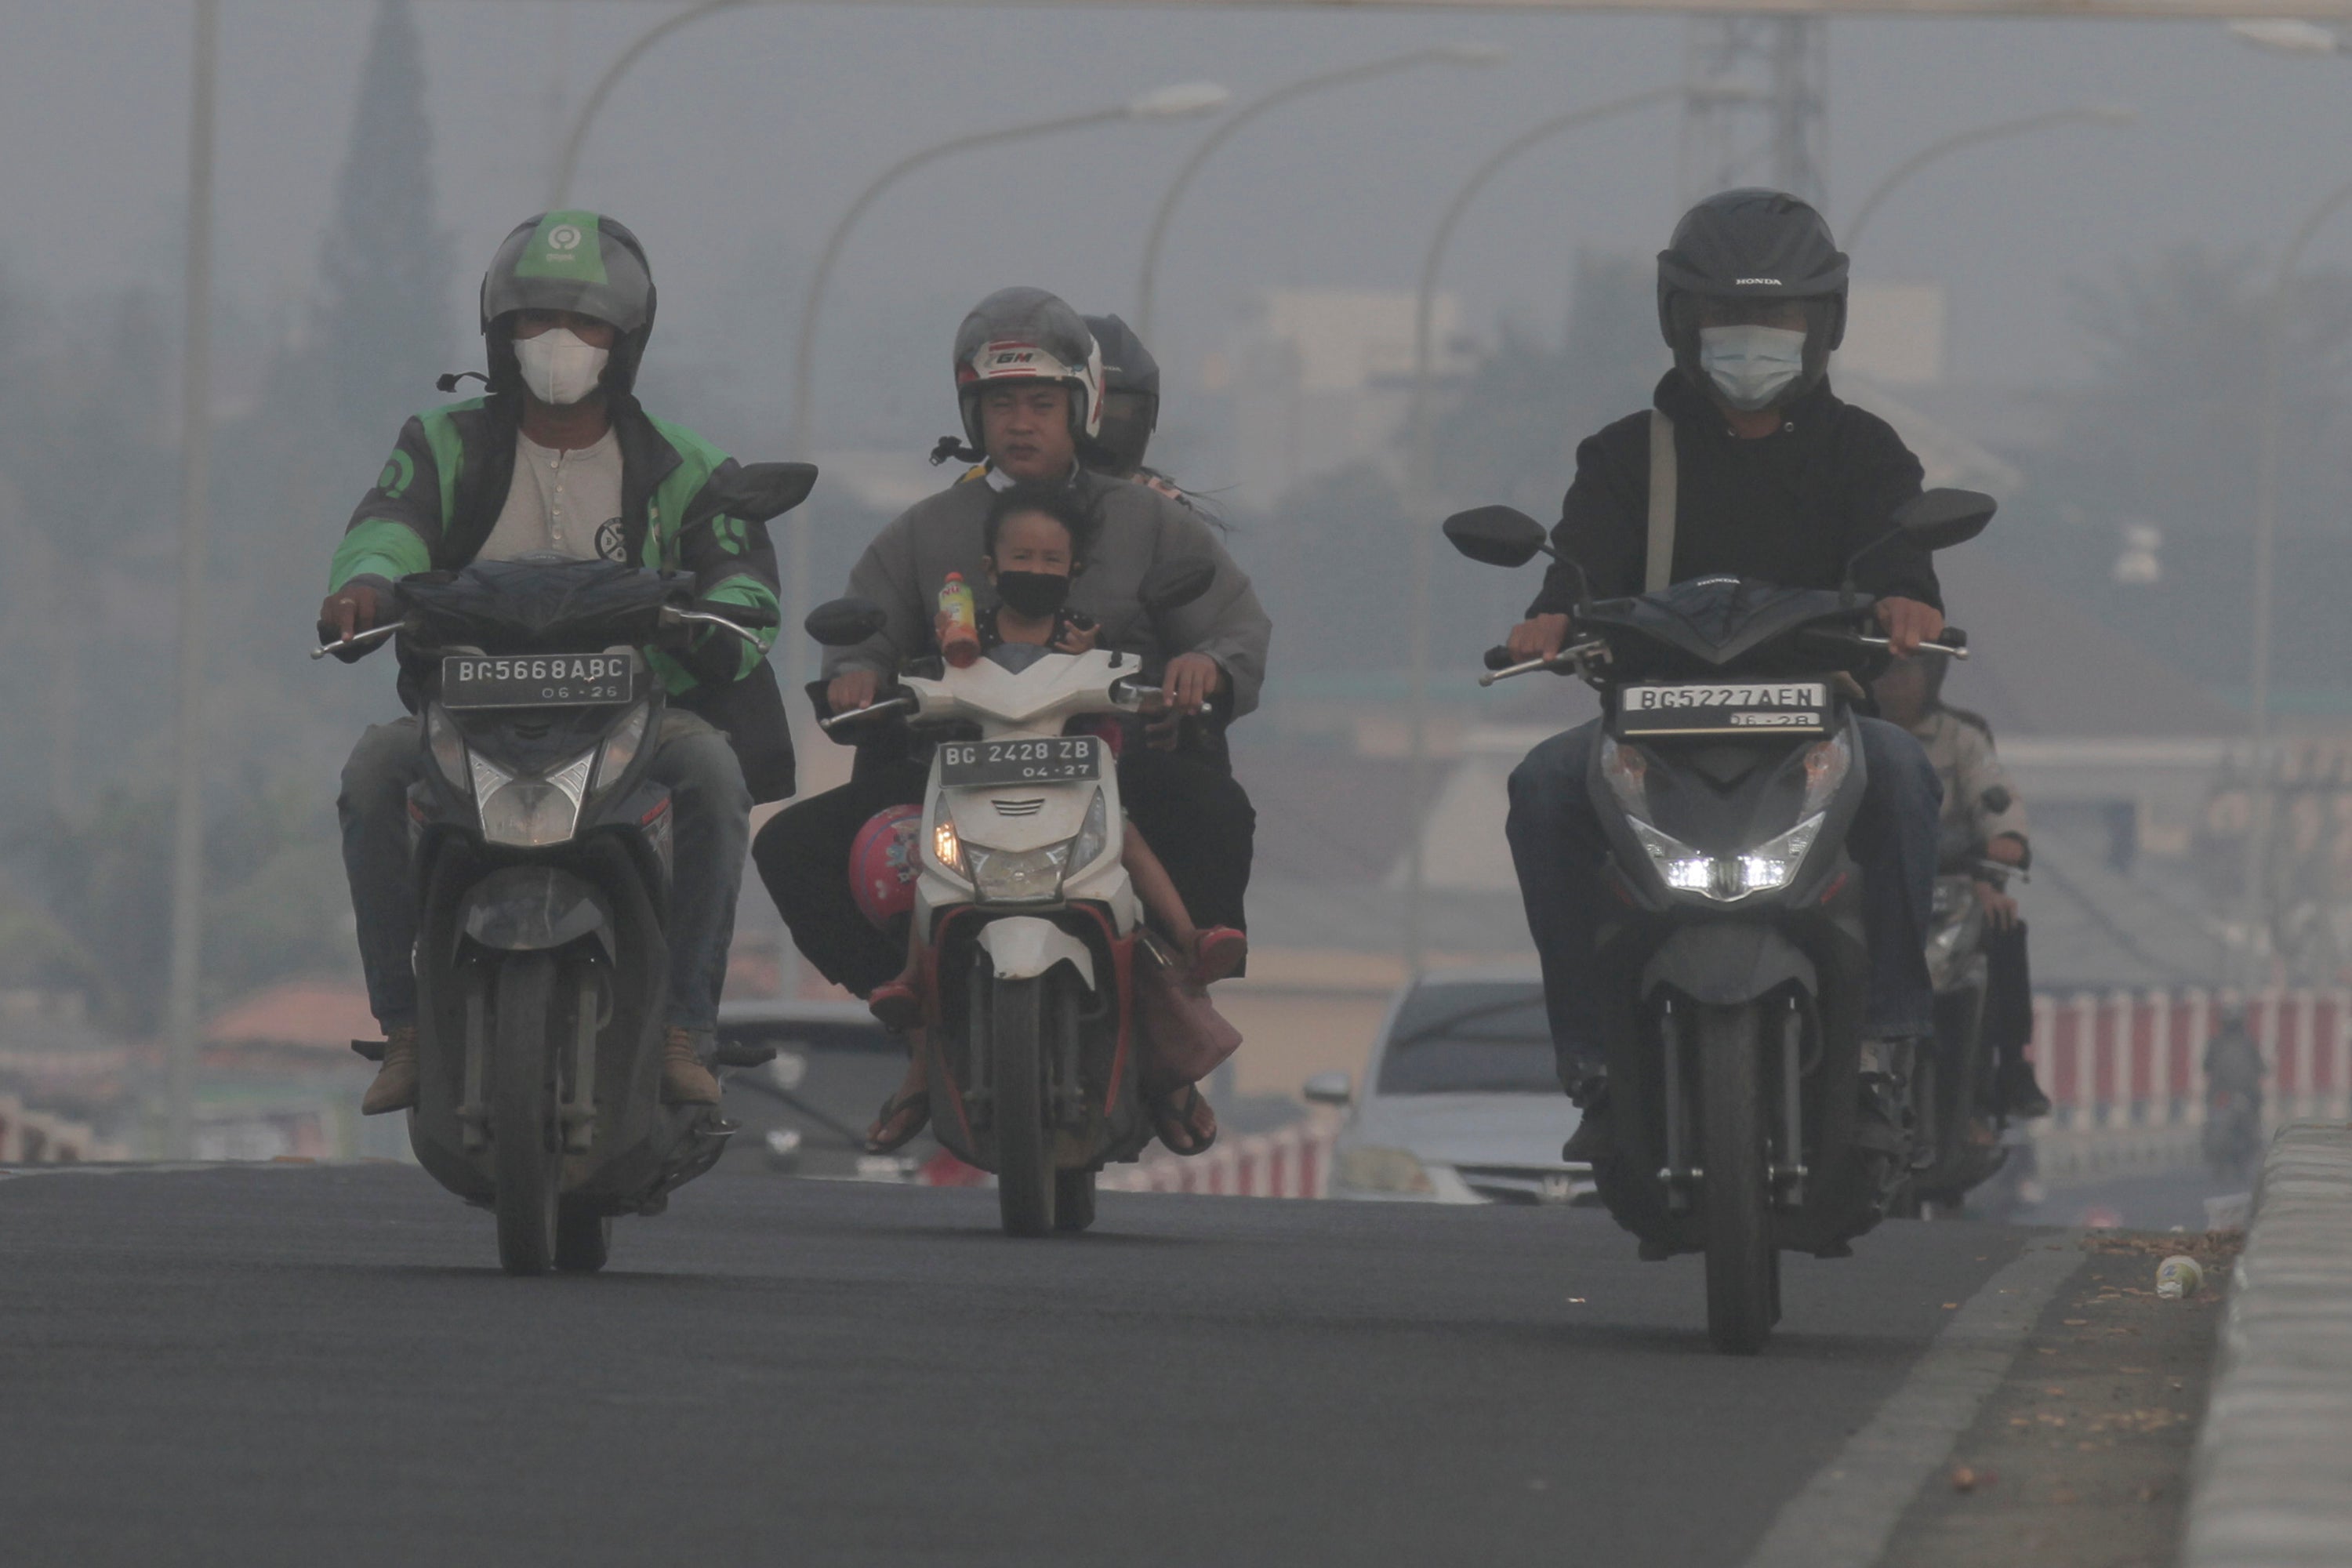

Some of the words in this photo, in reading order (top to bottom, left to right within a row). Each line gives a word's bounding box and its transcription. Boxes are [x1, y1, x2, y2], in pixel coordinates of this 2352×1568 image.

[996, 353, 1033, 364] GM
[946, 747, 976, 765] BG
[989, 742, 1048, 762] 2428
[1059, 741, 1089, 758] ZB
